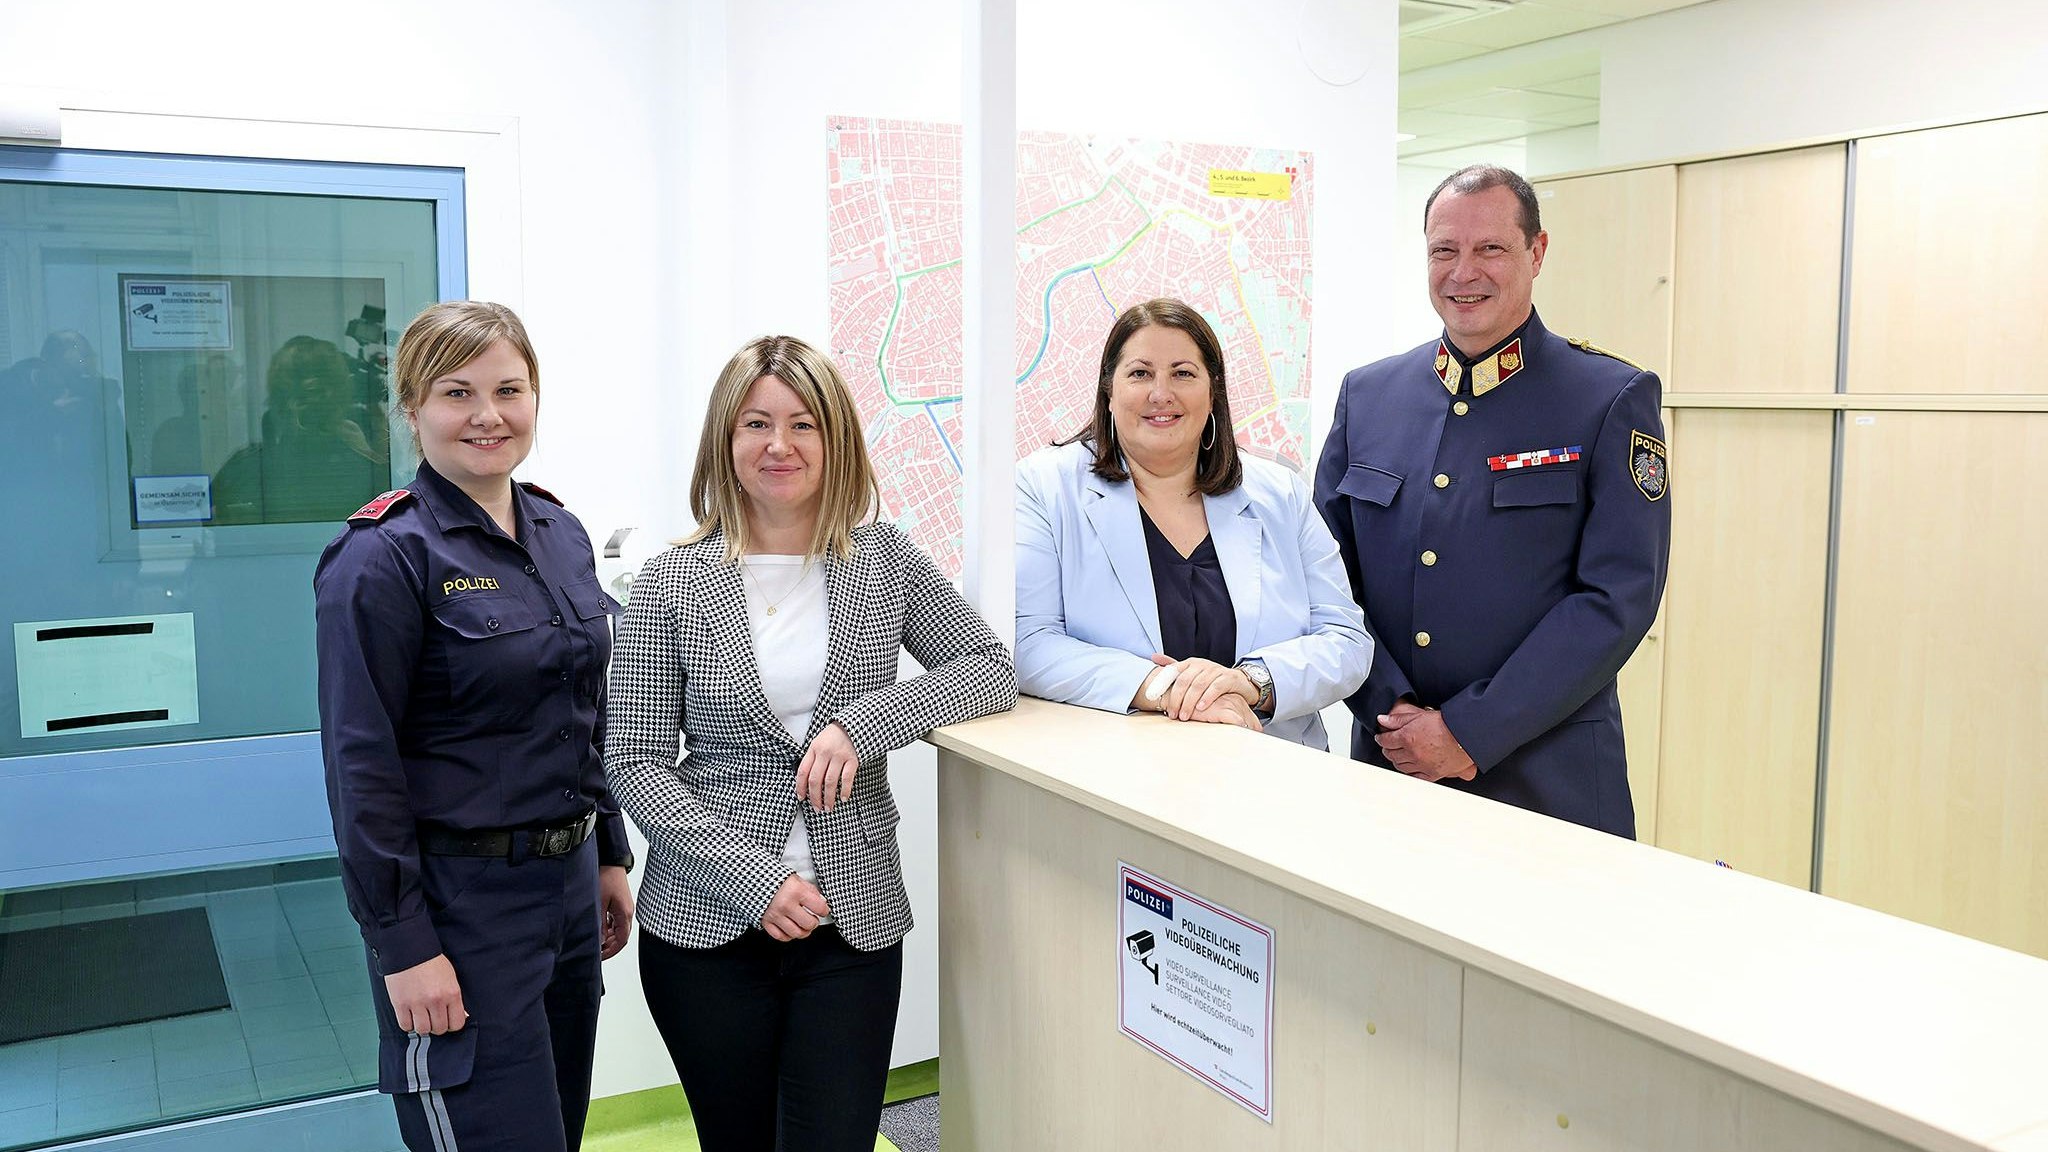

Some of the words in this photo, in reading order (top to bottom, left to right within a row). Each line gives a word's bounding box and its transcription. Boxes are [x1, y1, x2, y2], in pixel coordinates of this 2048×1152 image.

[443, 577, 500, 596] POLIZEI
[1127, 885, 1165, 913] POLIZEI
[1165, 927, 1259, 984] VIDEOÜBERWACHUNG
[1181, 917, 1241, 957] POLIZEILICHE
[1166, 957, 1184, 974] VIDEO
[1184, 967, 1232, 1000] SURVEILLANCE
[1166, 970, 1211, 1002] SURVEILLANCE
[1150, 1002, 1163, 1016] Hier
[1163, 1010, 1177, 1024] wird
[1177, 1019, 1233, 1056] echtzeitüberwacht!
[1166, 983, 1193, 1005] SETTORE
[1194, 997, 1255, 1038] VIDEOSORVEGLIATO
